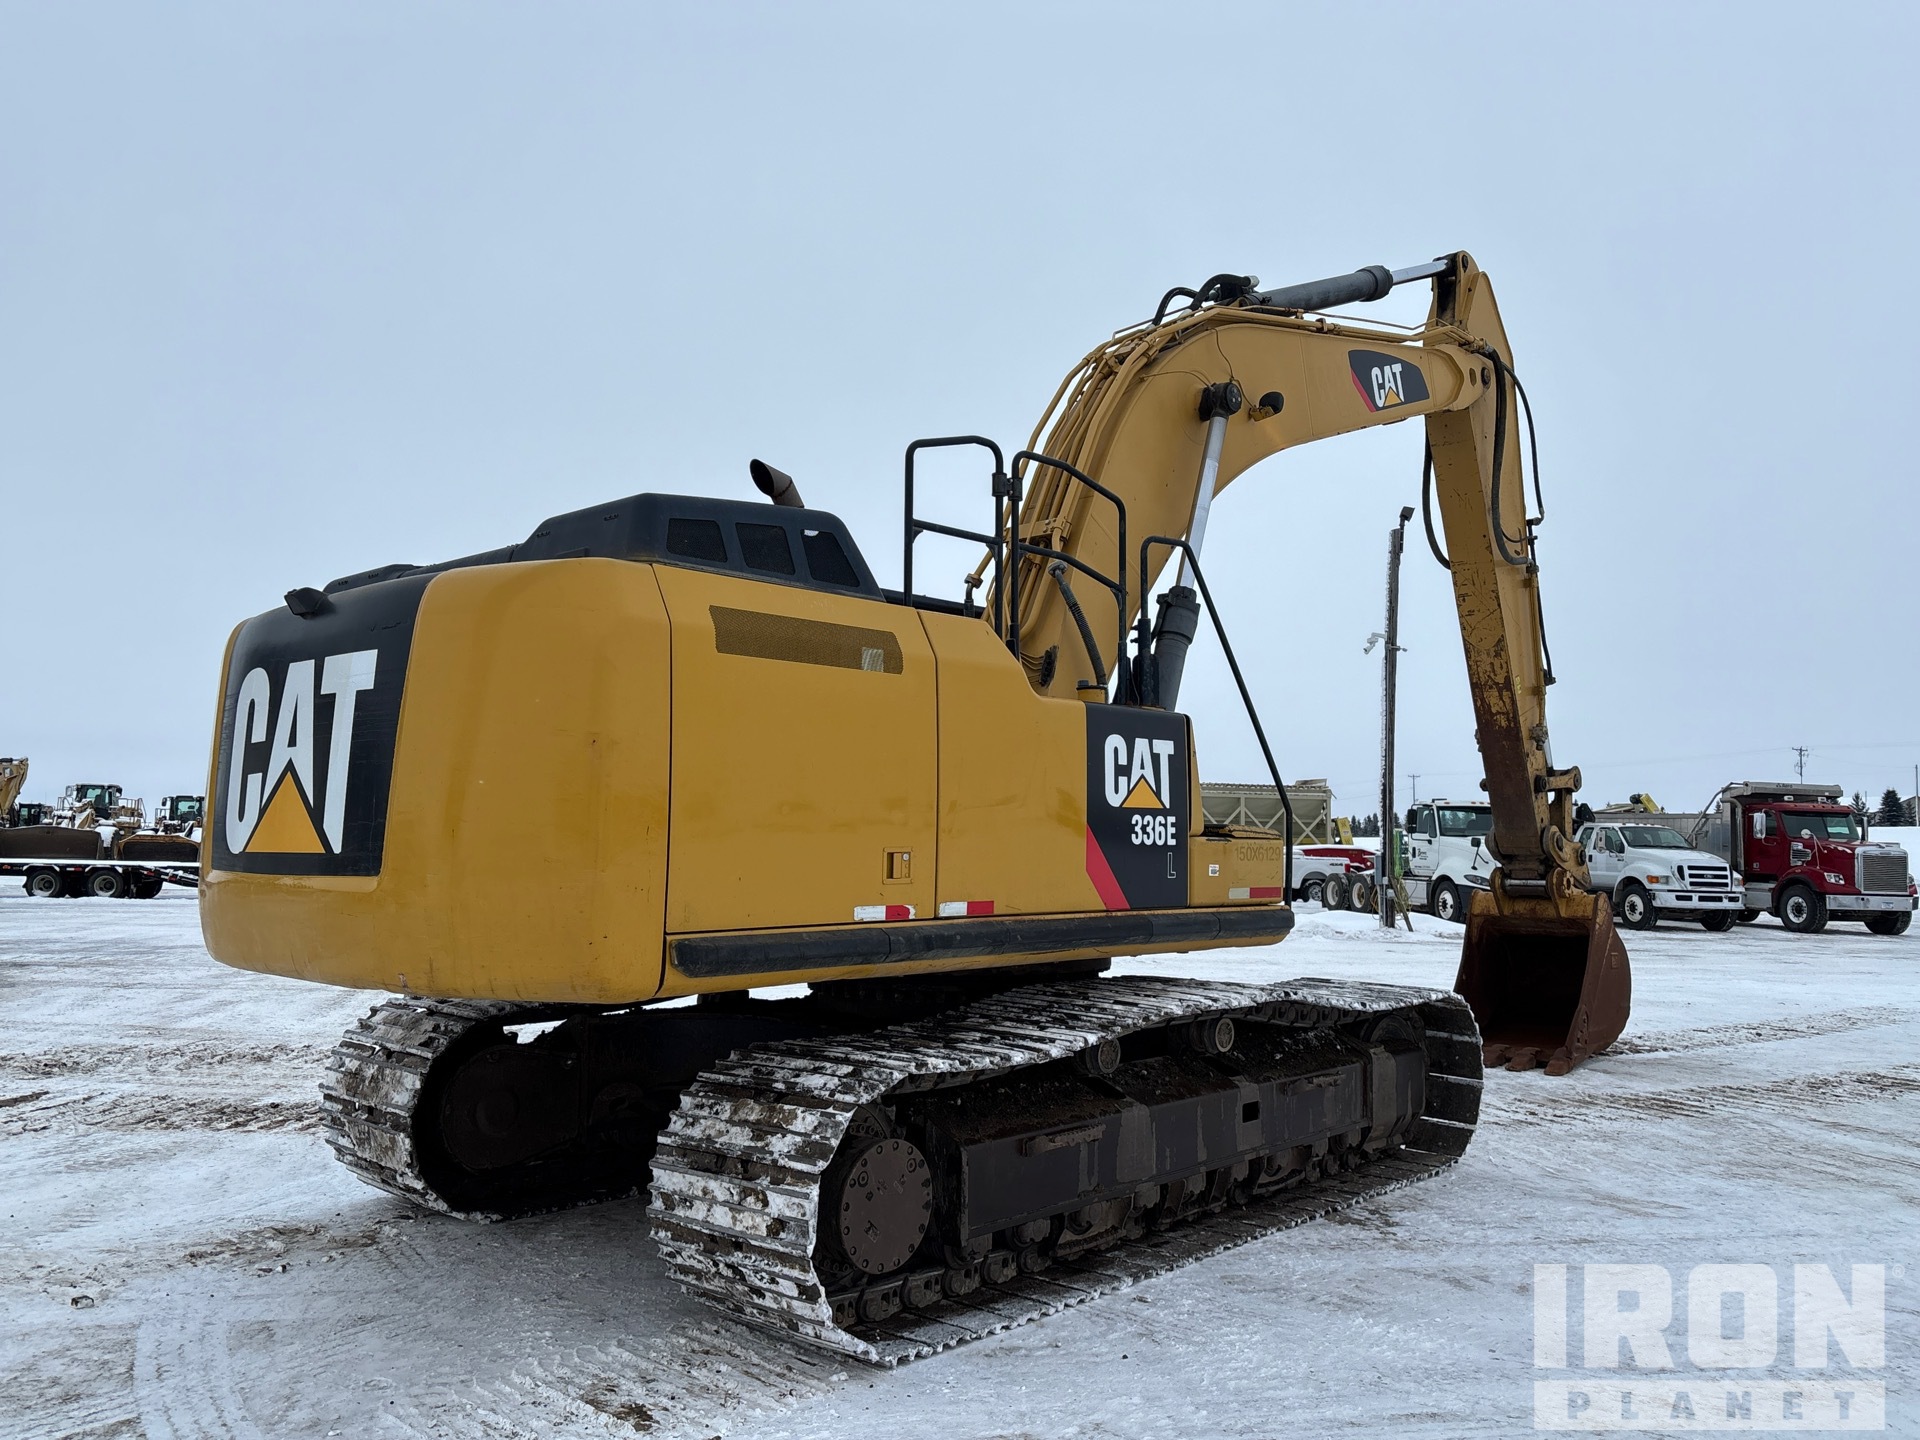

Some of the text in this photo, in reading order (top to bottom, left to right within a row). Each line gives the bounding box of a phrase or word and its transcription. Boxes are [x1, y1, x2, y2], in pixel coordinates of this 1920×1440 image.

[1371, 363, 1405, 408] CAT
[225, 649, 378, 854] CAT
[1104, 734, 1175, 809] CAT
[1131, 814, 1177, 846] 336E
[1167, 852, 1177, 878] L
